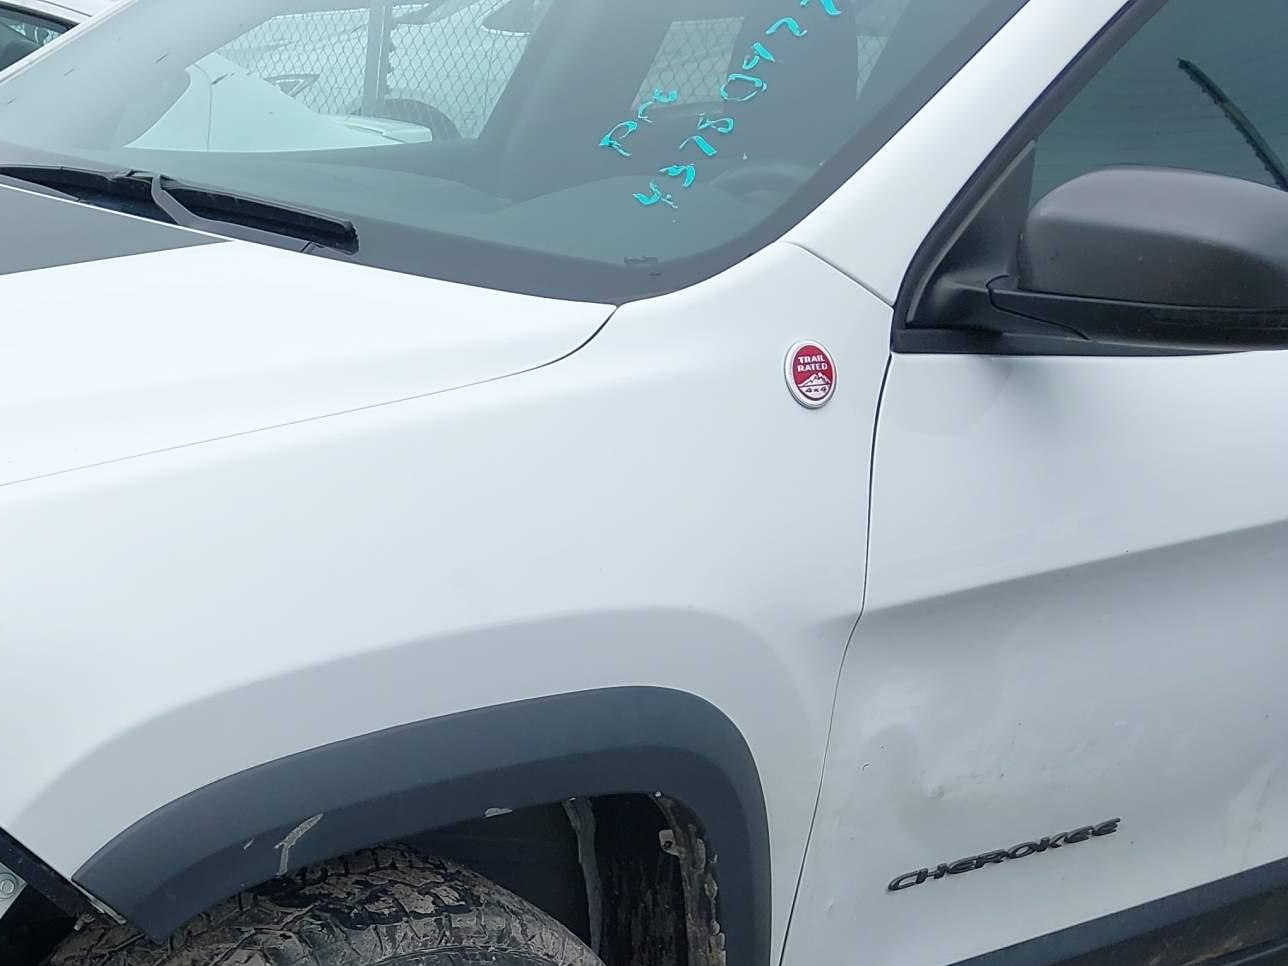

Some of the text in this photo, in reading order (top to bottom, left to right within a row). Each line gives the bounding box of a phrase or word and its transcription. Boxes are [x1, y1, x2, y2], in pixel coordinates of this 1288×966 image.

[798, 354, 825, 364] TRAIL
[797, 363, 828, 373] RATED
[887, 817, 1121, 891] CHEROKEE
